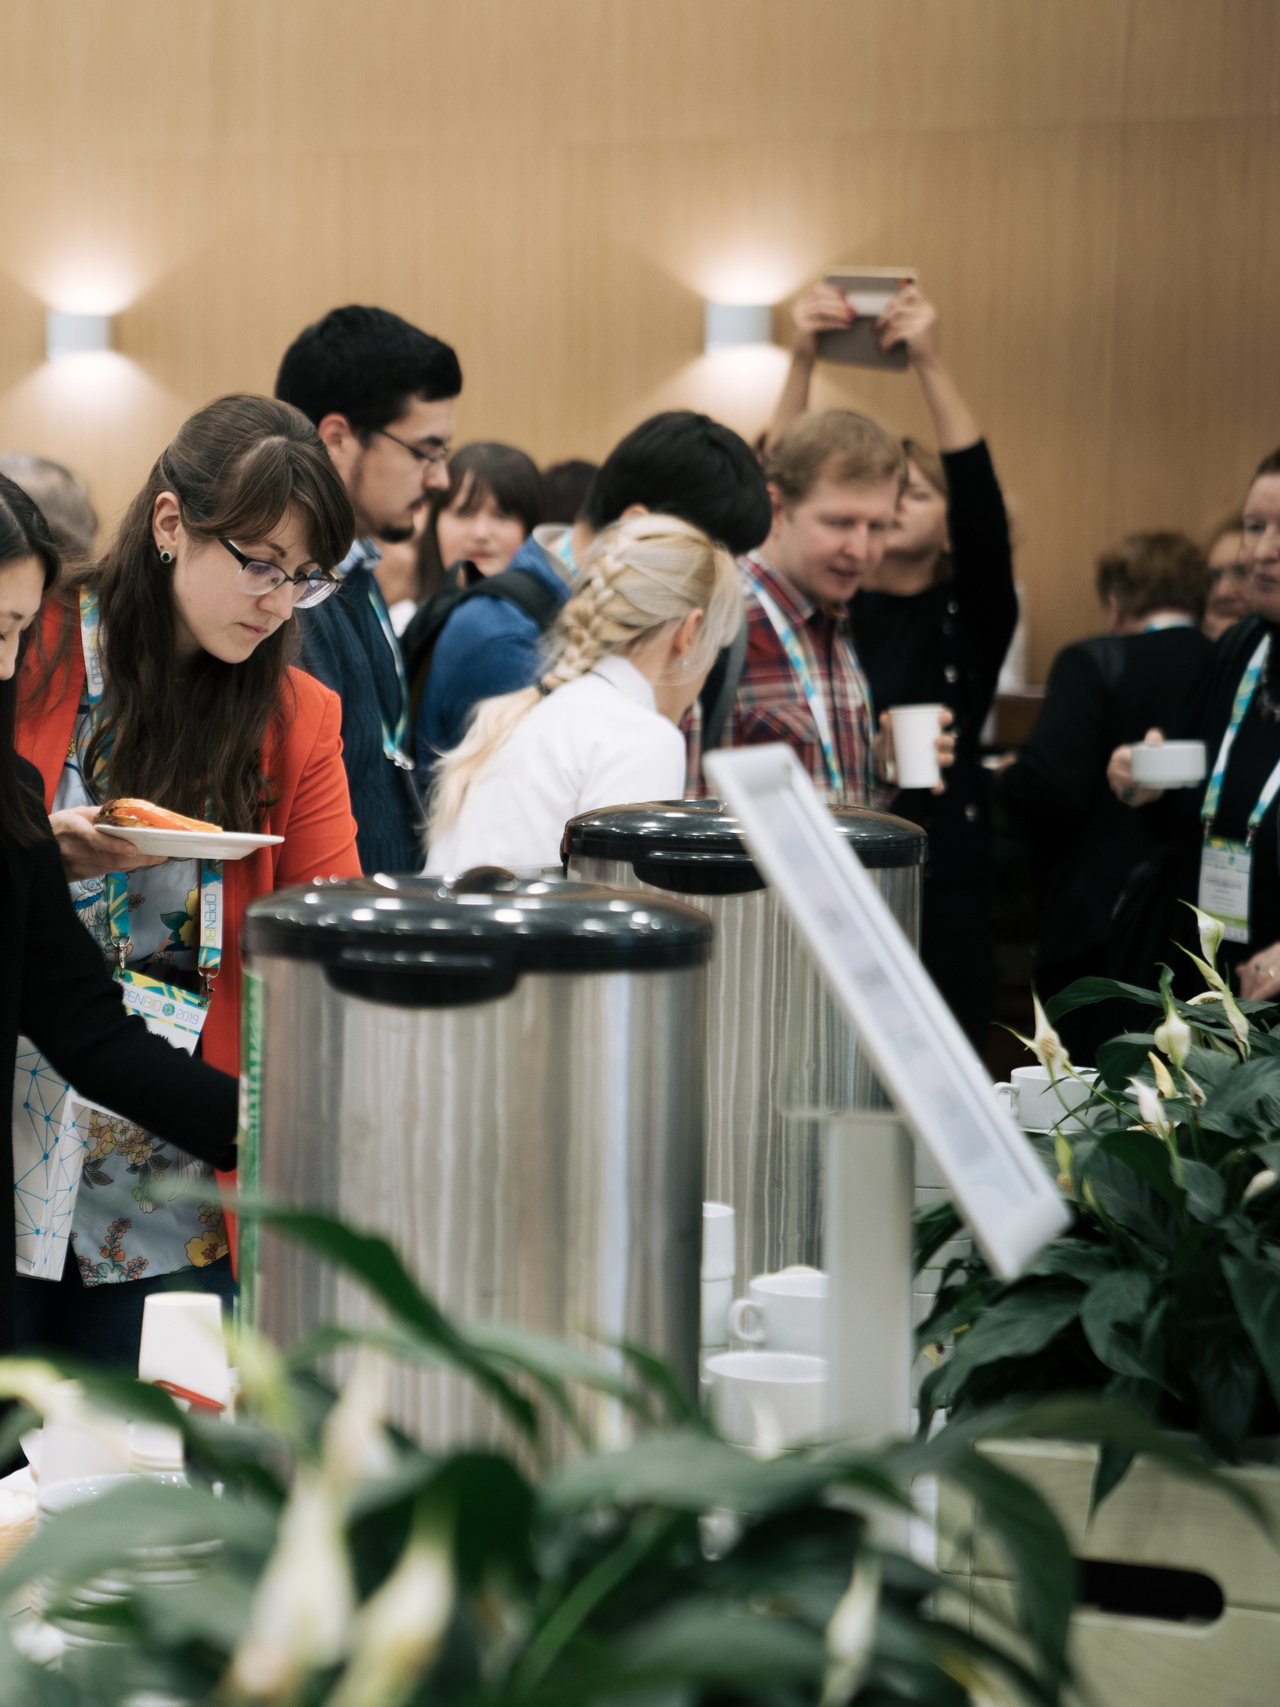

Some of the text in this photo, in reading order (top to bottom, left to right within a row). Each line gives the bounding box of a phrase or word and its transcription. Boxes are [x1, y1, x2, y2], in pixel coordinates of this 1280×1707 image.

[204, 893, 217, 948] OPENBIO
[122, 988, 200, 1026] PENBIO 2019
